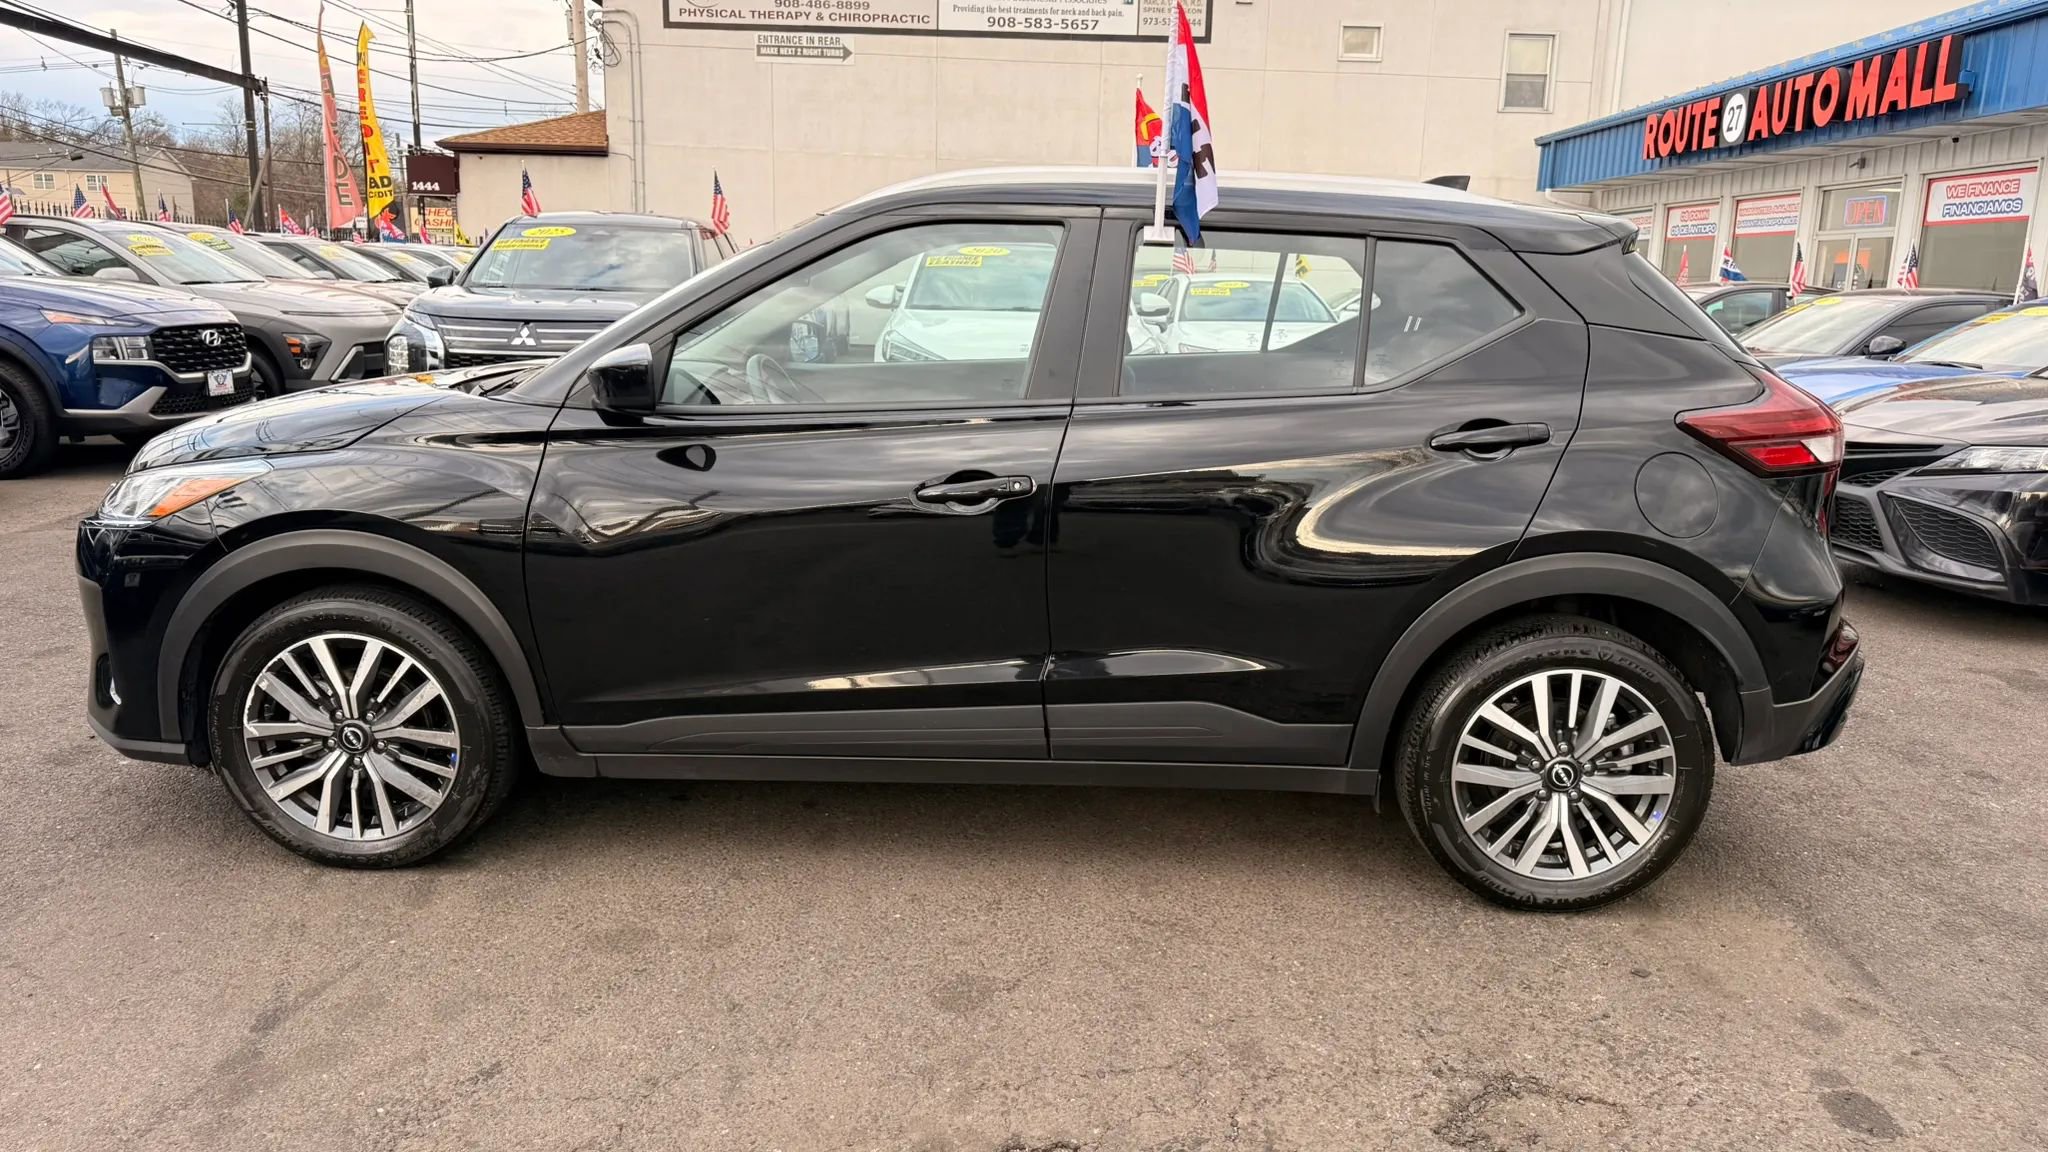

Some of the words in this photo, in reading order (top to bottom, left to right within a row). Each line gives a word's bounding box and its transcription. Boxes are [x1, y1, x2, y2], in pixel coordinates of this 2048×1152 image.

[679, 8, 746, 19] PHYSICAL
[749, 10, 811, 20] THERAPY
[815, 12, 824, 21] &
[828, 13, 930, 24] CHIROPRACTIC
[953, 4, 985, 14] Providing
[986, 5, 998, 13] the
[999, 6, 1012, 14] best
[1013, 6, 1049, 15] treatments
[1050, 7, 1060, 15] for
[1061, 8, 1076, 16] neck
[1077, 8, 1090, 16] and
[1091, 8, 1106, 17] back
[987, 16, 1099, 30] 908-583-5657
[757, 34, 803, 45] ENTRANCE
[806, 36, 815, 45] IN
[818, 36, 841, 46] REAR
[760, 46, 778, 55] MAKE
[779, 47, 795, 55] NEXT
[796, 47, 802, 55] 2
[803, 48, 822, 56] RIGHT
[823, 49, 844, 57] TURNS
[1642, 97, 1721, 160] ROUTE
[1726, 104, 1743, 132] 27
[1748, 67, 1840, 141] AUTO
[1845, 35, 1957, 122] MALL
[412, 181, 440, 191] 1444
[1946, 183, 1967, 199] WE
[1967, 178, 2021, 197] FINANCE
[1942, 199, 2022, 218] FINANCIAMOS
